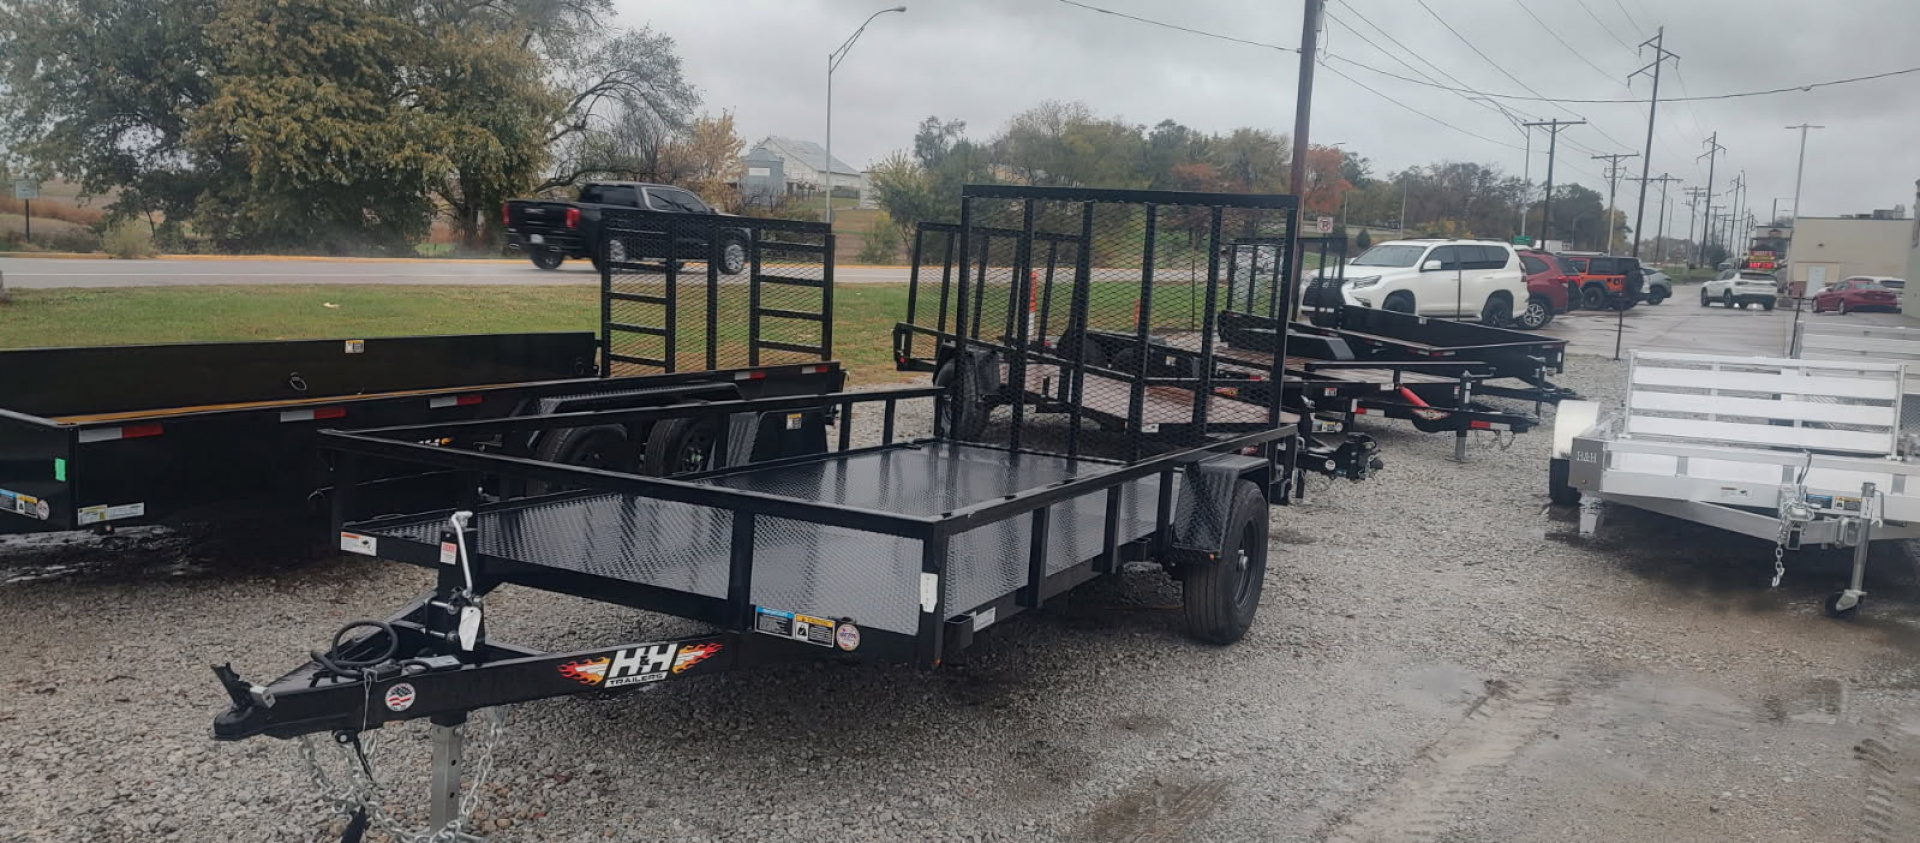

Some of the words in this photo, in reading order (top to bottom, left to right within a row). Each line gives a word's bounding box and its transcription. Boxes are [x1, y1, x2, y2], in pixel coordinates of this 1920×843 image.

[1577, 451, 1597, 463] H&H
[608, 643, 678, 678] H&H
[609, 673, 664, 686] TRAILERS
